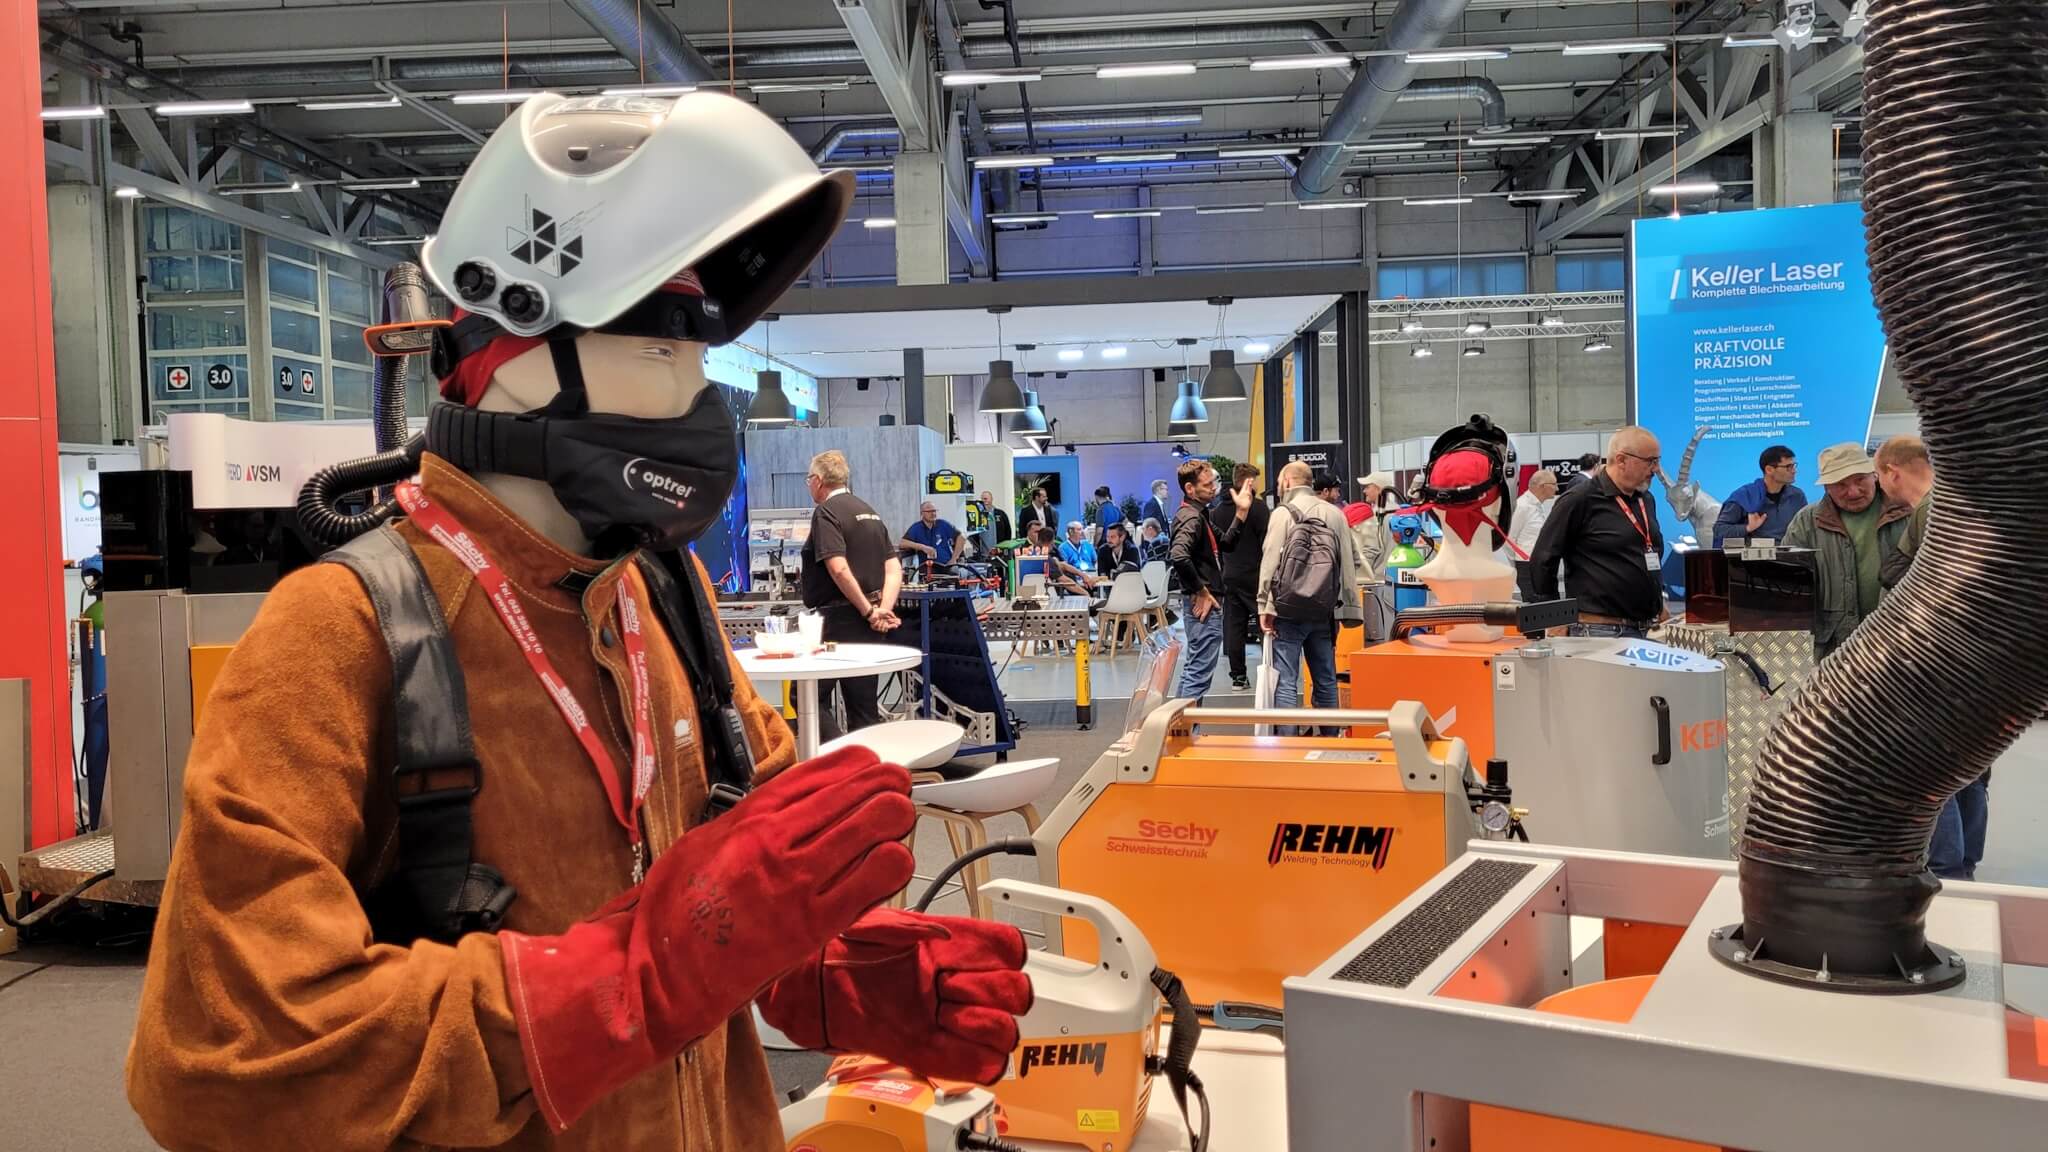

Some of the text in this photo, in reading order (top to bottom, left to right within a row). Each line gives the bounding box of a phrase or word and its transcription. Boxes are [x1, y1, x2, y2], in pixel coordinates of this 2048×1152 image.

[1691, 261, 1844, 288] Keller Laser
[1691, 280, 1846, 300] Komplette Blechbearbeitung
[1693, 323, 1775, 336] www.kellerlaser.ch
[1693, 337, 1786, 354] KRAFTVOLLE
[1693, 353, 1773, 370] PRÄZISION
[210, 369, 231, 385] 3.0
[281, 371, 293, 386] 3.0
[642, 470, 694, 499] optrel
[1106, 841, 1209, 860] Schweisstechnik
[1268, 823, 1395, 870] REHM
[1282, 854, 1371, 868] Welding Technology
[1018, 1040, 1108, 1078] REHM
